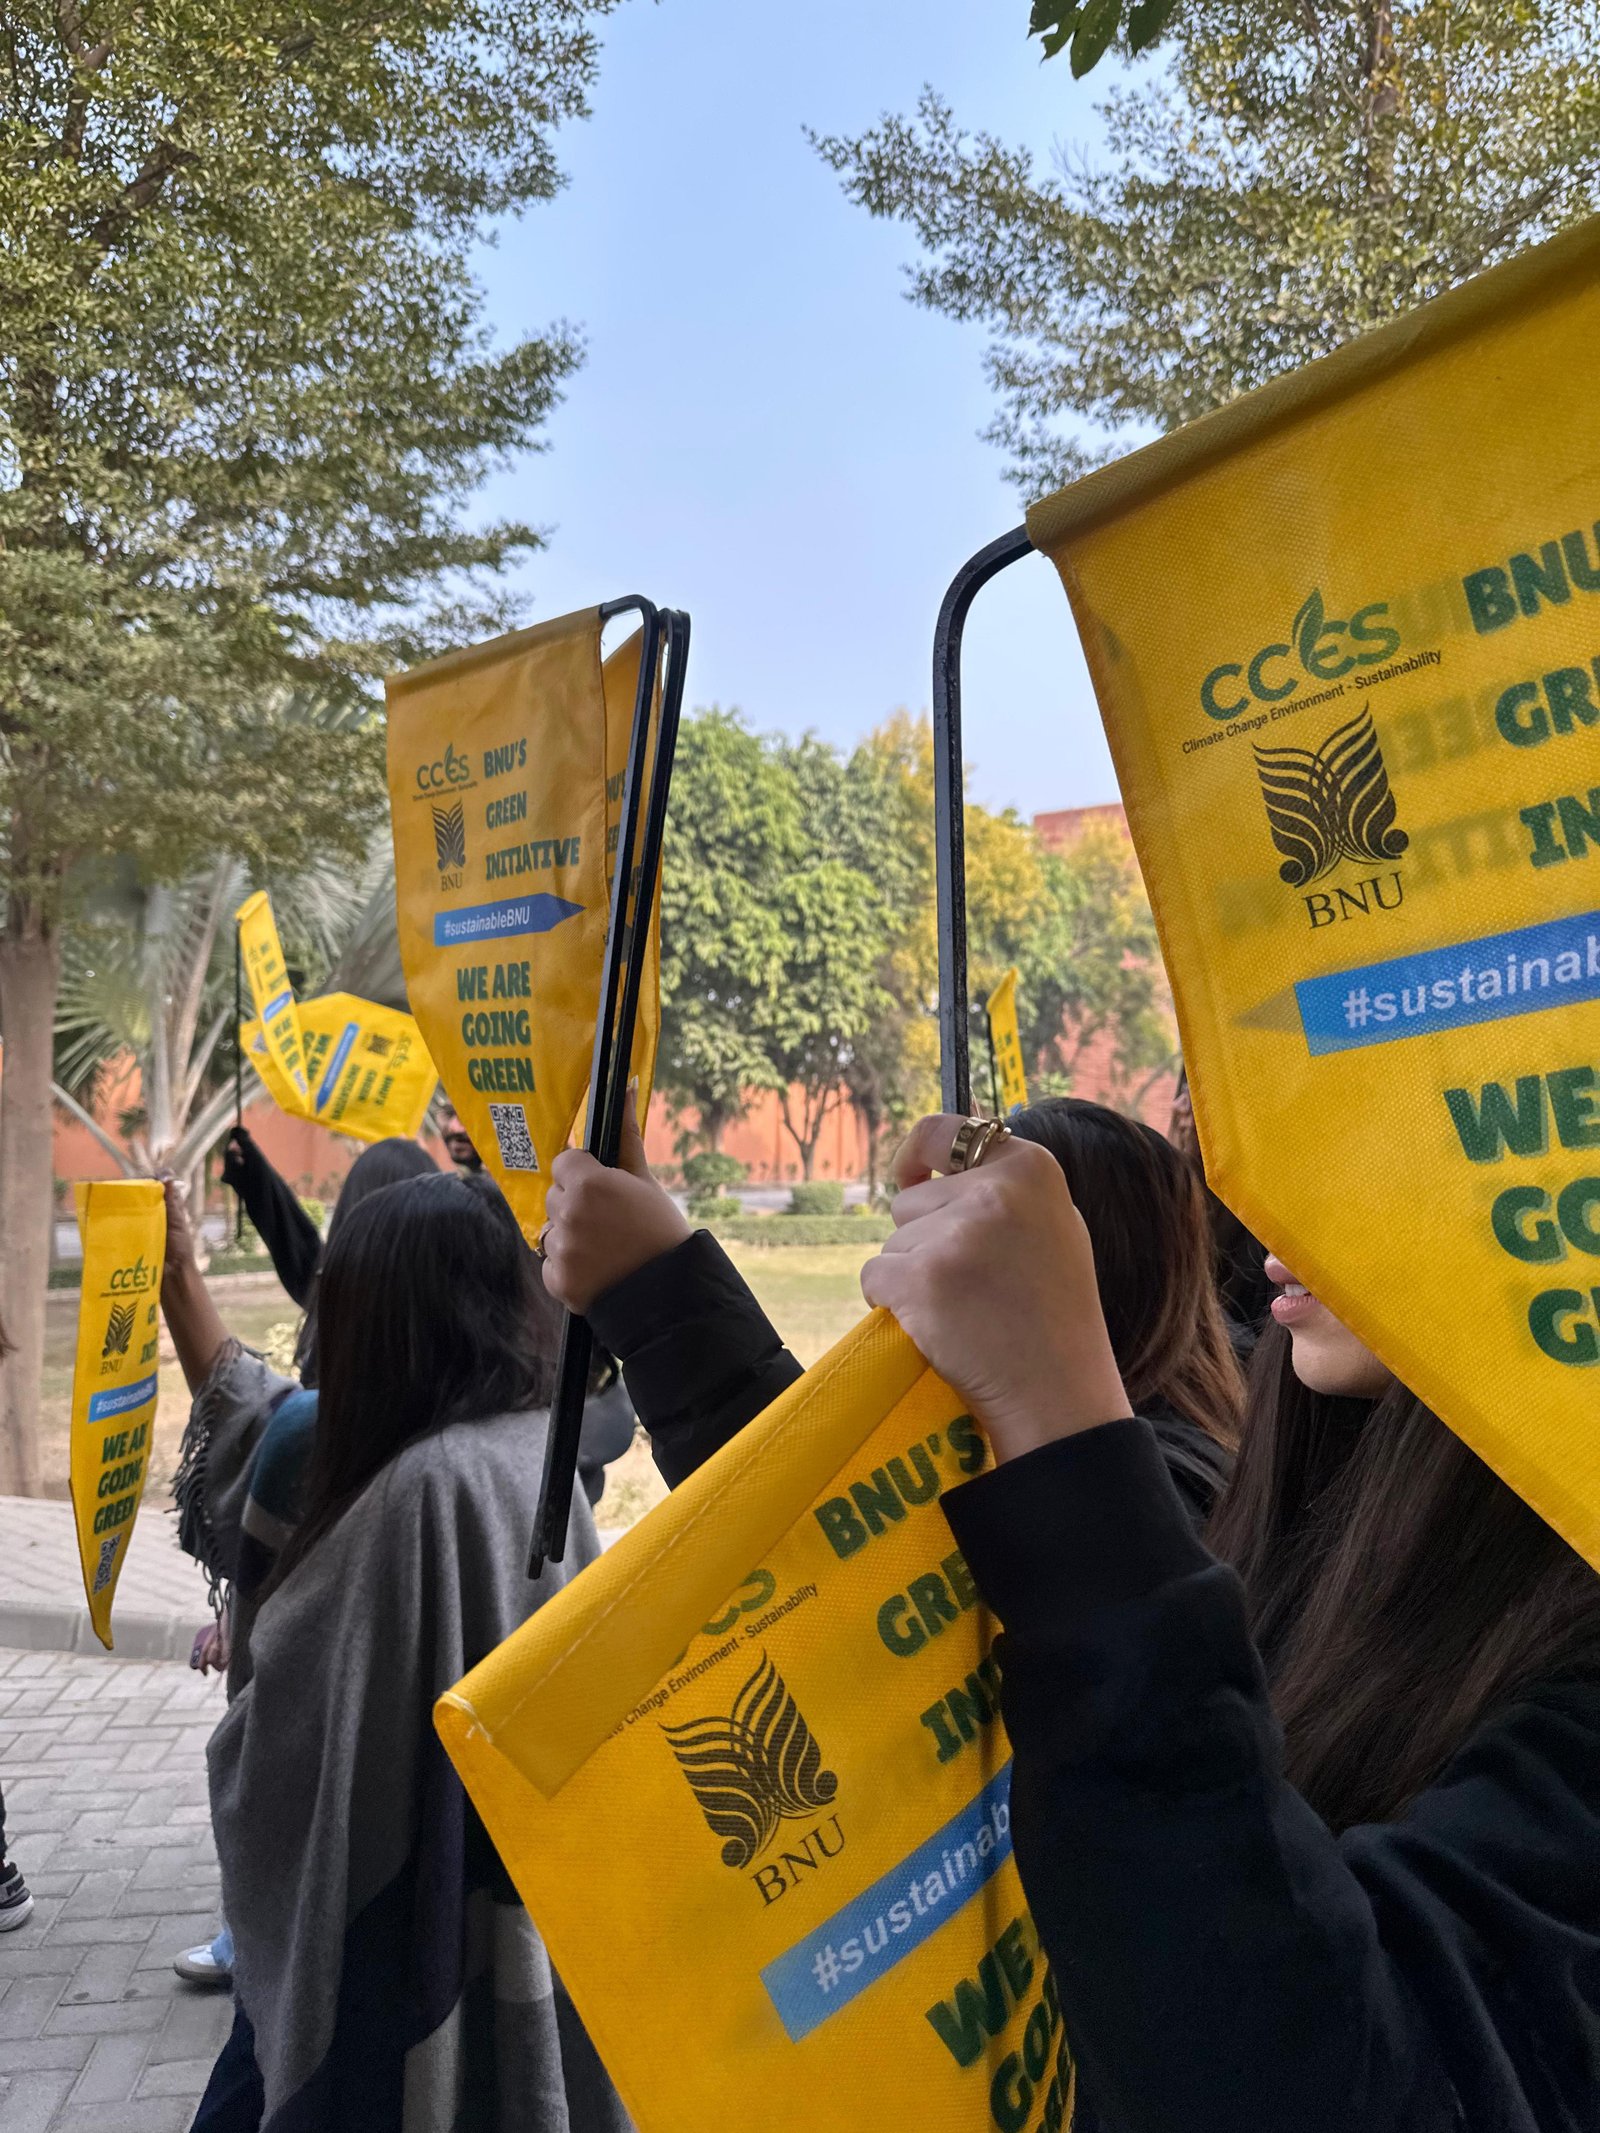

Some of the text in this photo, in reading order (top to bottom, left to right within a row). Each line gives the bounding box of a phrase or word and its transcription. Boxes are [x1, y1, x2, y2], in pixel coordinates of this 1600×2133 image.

[1182, 731, 1224, 755] Climate
[1226, 714, 1269, 739] Change
[1271, 684, 1345, 721] Environment
[1354, 649, 1442, 690] Sustainability
[1494, 655, 1600, 749] GR
[483, 738, 527, 780] BNU'S
[486, 790, 527, 831] GREEN
[486, 836, 581, 881] INITIATIVE
[440, 872, 463, 893] BNU
[1302, 872, 1405, 929] BNU
[444, 905, 531, 937] #sustainableBNU
[457, 960, 532, 1002] WE ARE
[461, 1009, 531, 1047] GOING
[467, 1057, 536, 1093] GREEN
[102, 1431, 129, 1464] WE
[812, 1414, 986, 1562] BNU'S
[667, 1637, 740, 1693] Environment
[744, 1582, 818, 1640] Sustainability
[750, 1813, 846, 1907] BNU
[810, 1800, 1010, 1994] #sustainab
[925, 1917, 1035, 2068] WE
